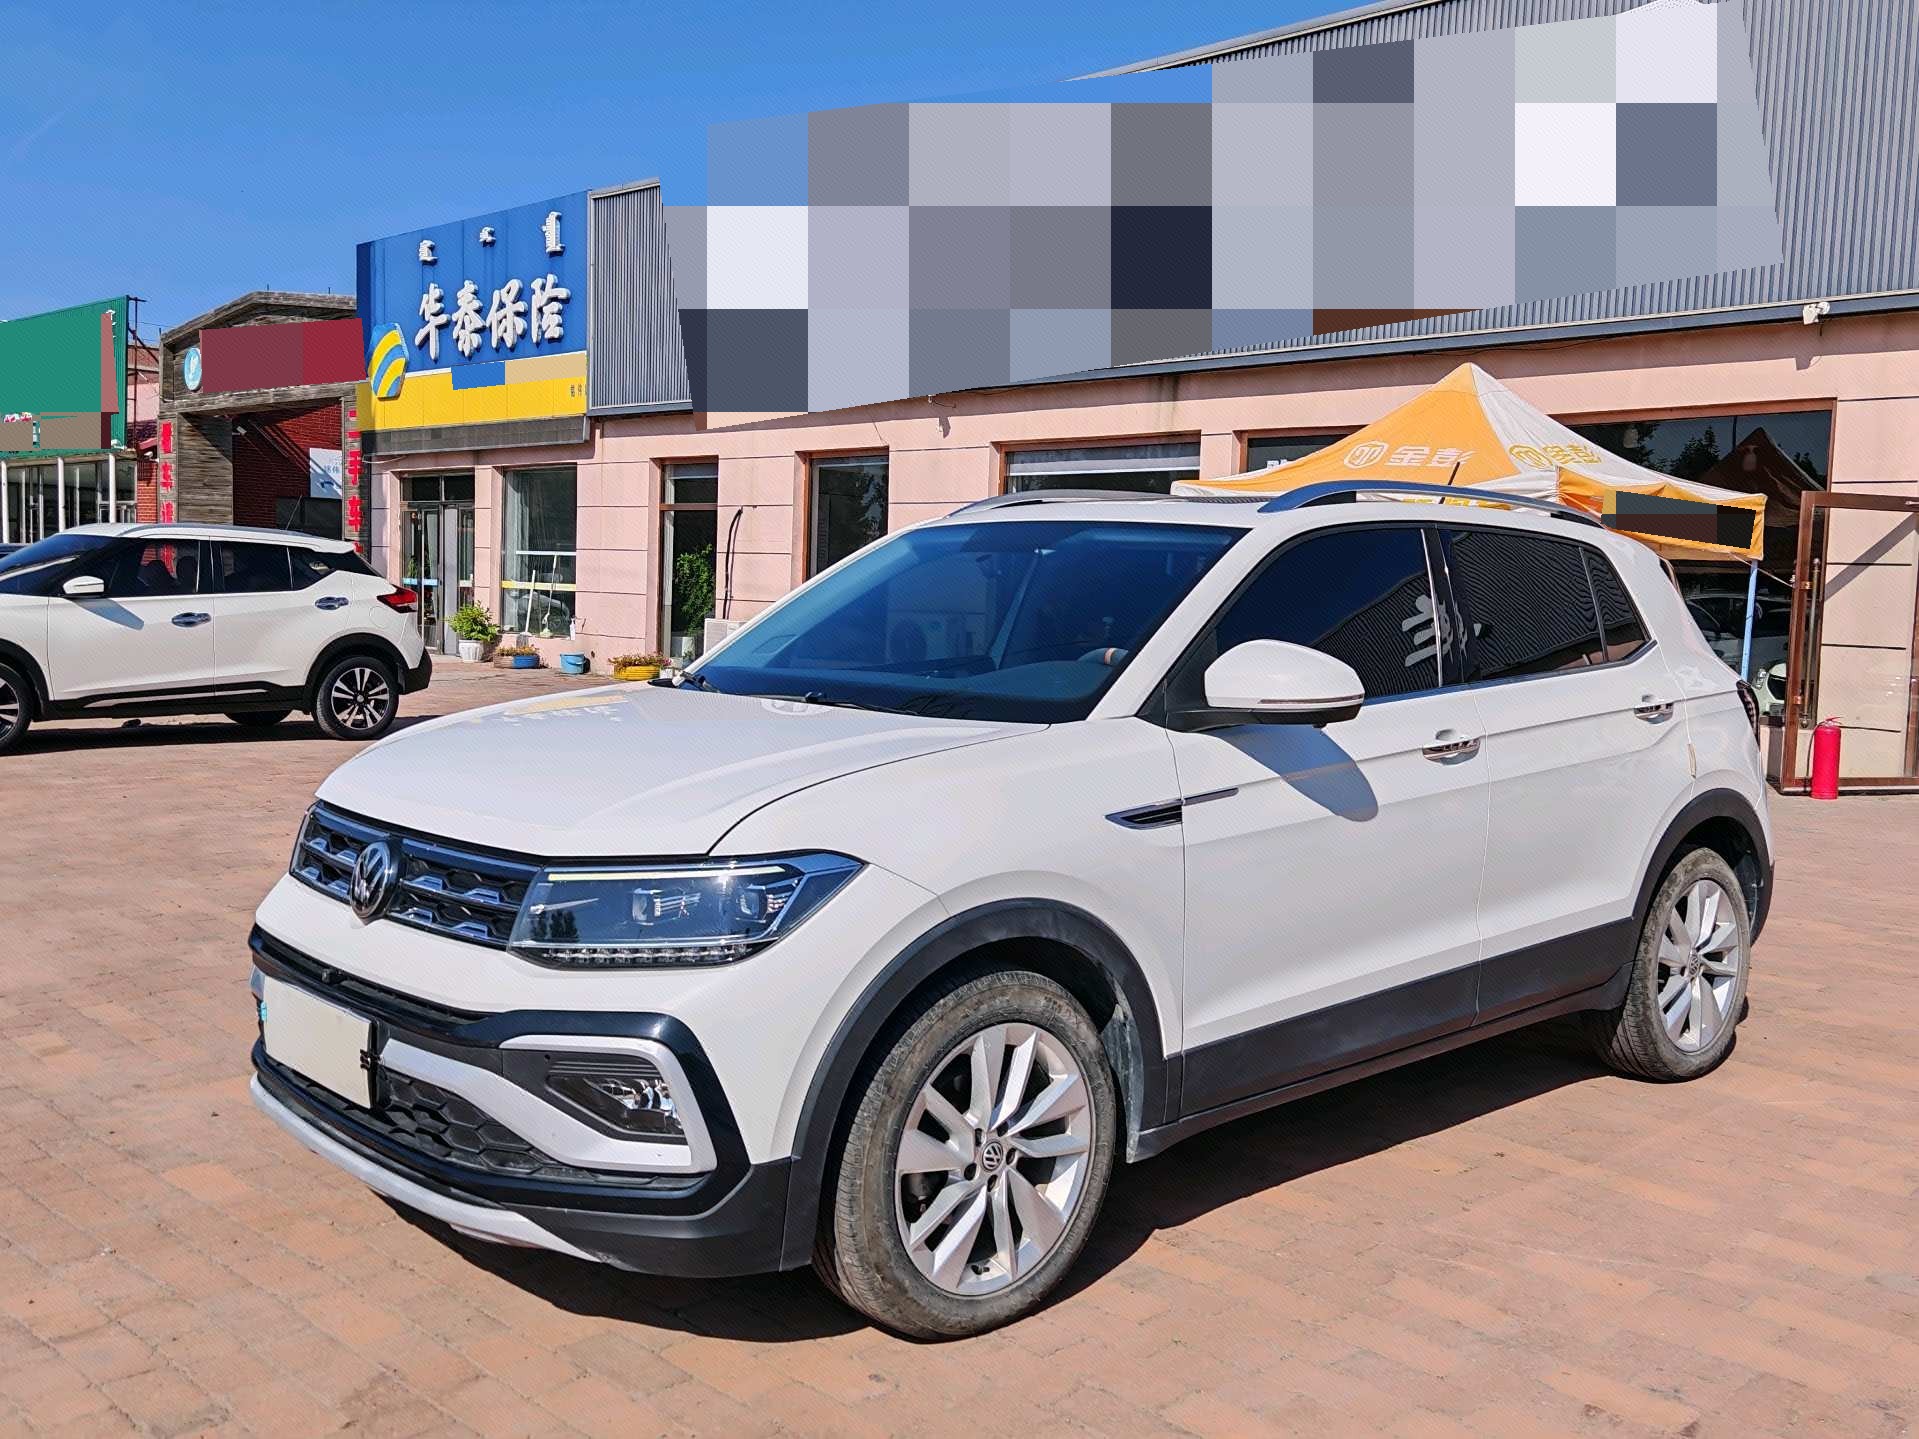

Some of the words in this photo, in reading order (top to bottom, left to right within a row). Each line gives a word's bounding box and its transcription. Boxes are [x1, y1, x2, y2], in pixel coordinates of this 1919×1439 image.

[415, 274, 571, 360] 华泰保险
[1384, 445, 1478, 468] 金彭
